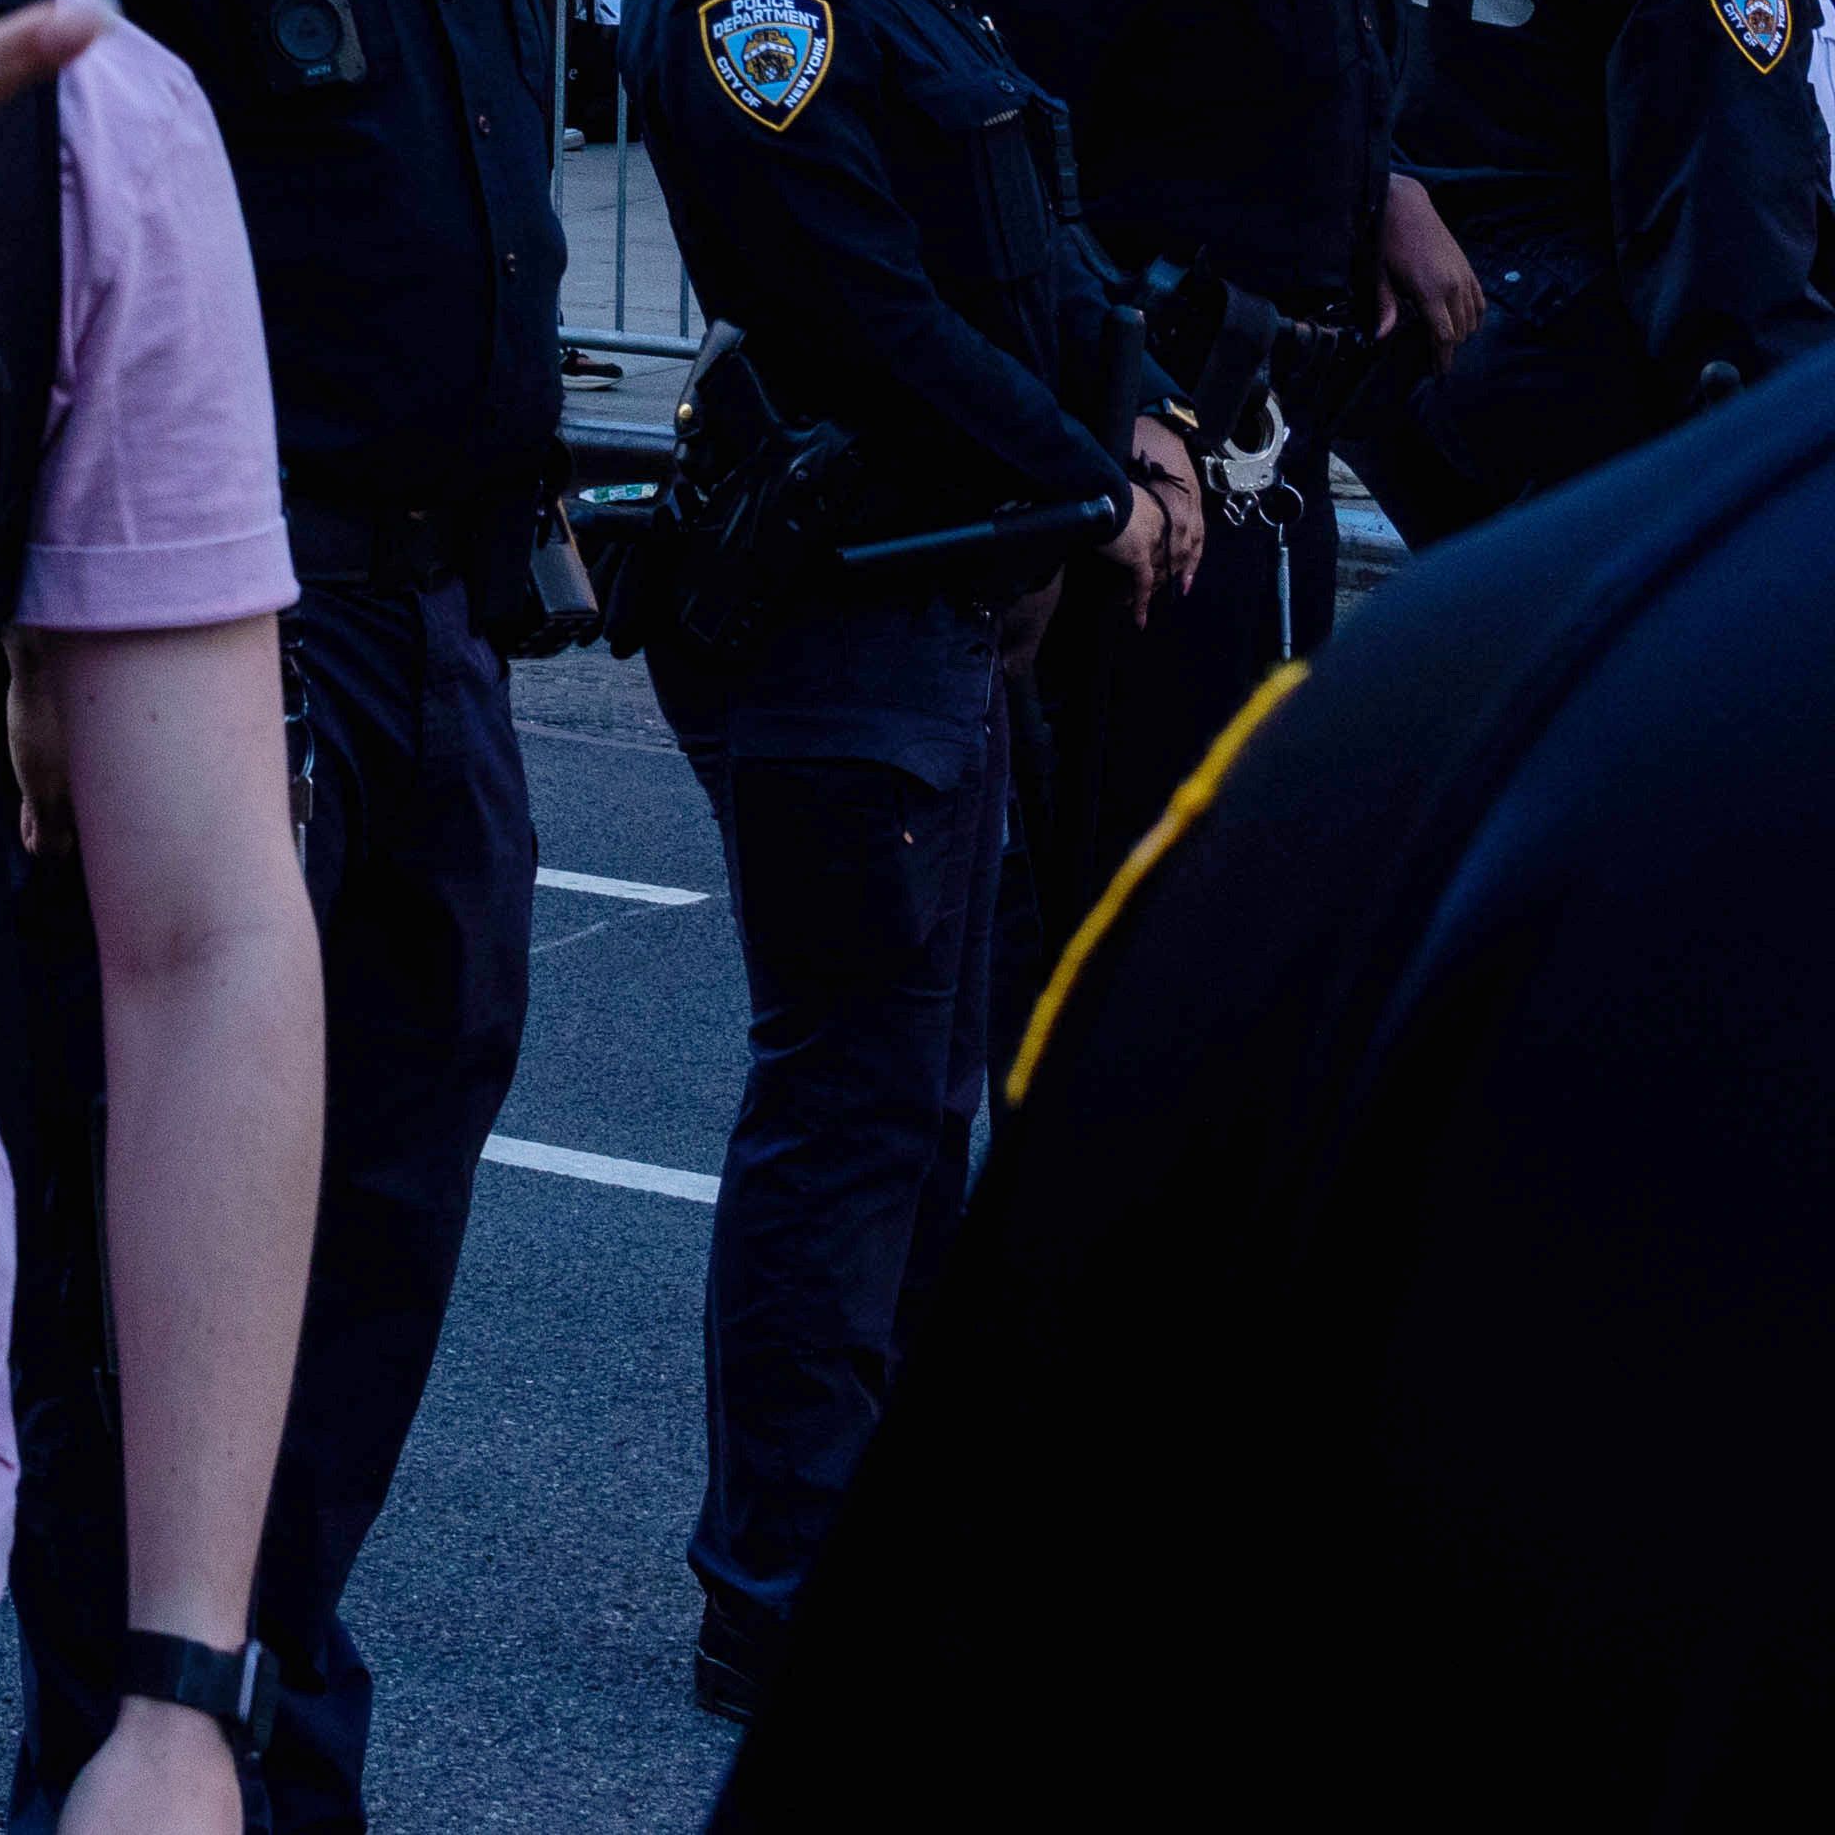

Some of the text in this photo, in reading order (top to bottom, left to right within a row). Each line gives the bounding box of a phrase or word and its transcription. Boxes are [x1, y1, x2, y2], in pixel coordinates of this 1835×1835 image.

[712, 8, 820, 41] DEPARTMENT
[1723, 3, 1758, 47] CITY OF
[716, 55, 762, 108] CITY OF
[784, 37, 827, 109] NEW YORK
